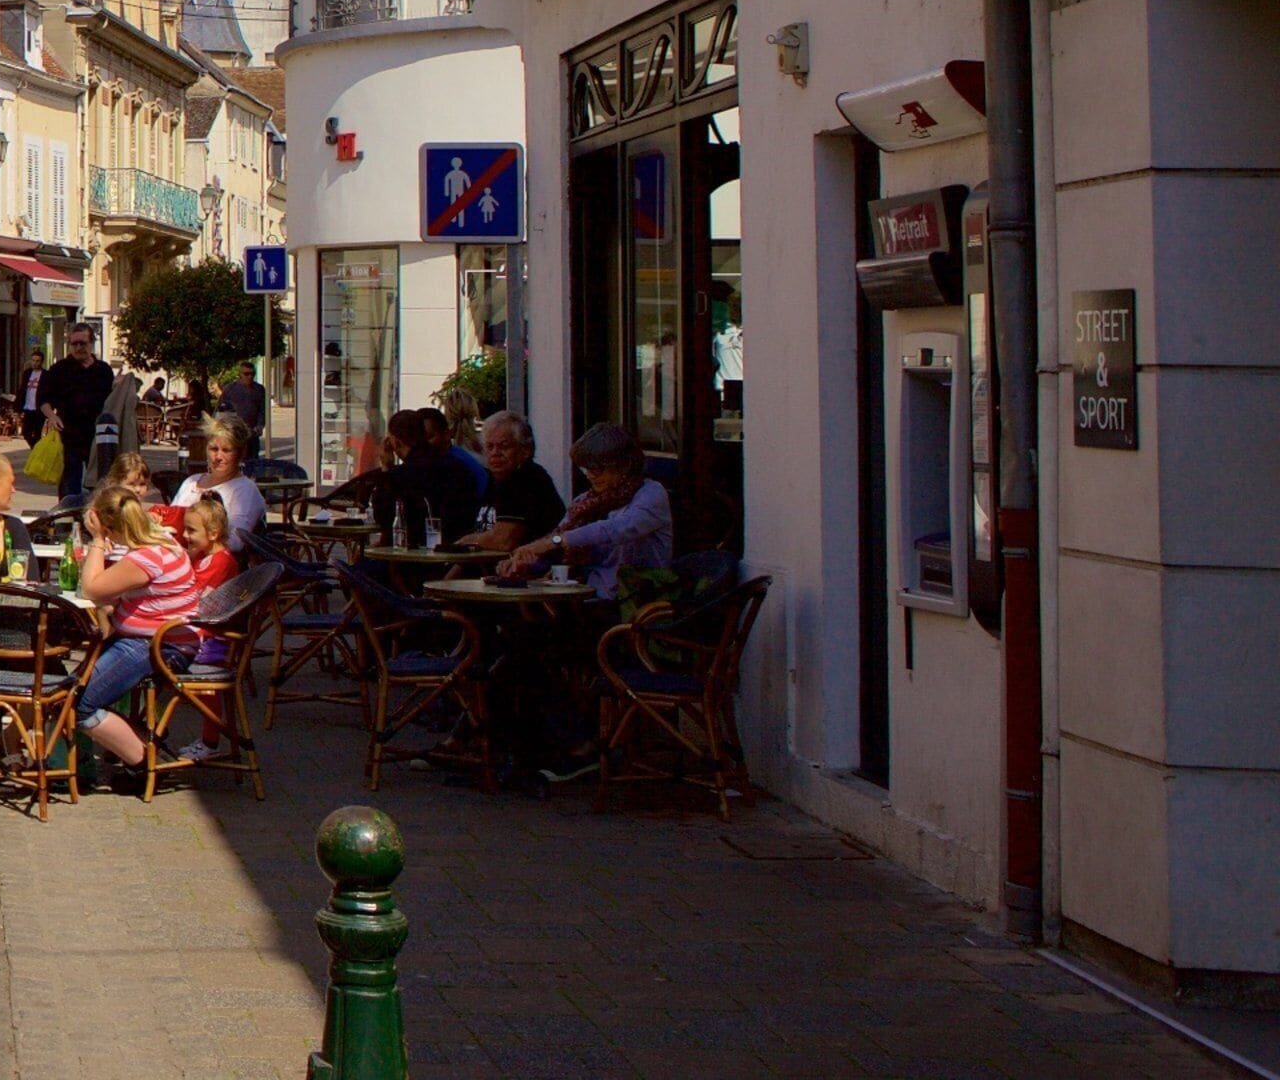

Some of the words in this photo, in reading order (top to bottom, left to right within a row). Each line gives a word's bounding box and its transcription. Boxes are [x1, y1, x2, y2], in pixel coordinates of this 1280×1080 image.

[891, 214, 930, 241] Retrait
[1076, 309, 1130, 342] STREET
[1096, 352, 1109, 387] &
[1079, 396, 1128, 430] SPORT
